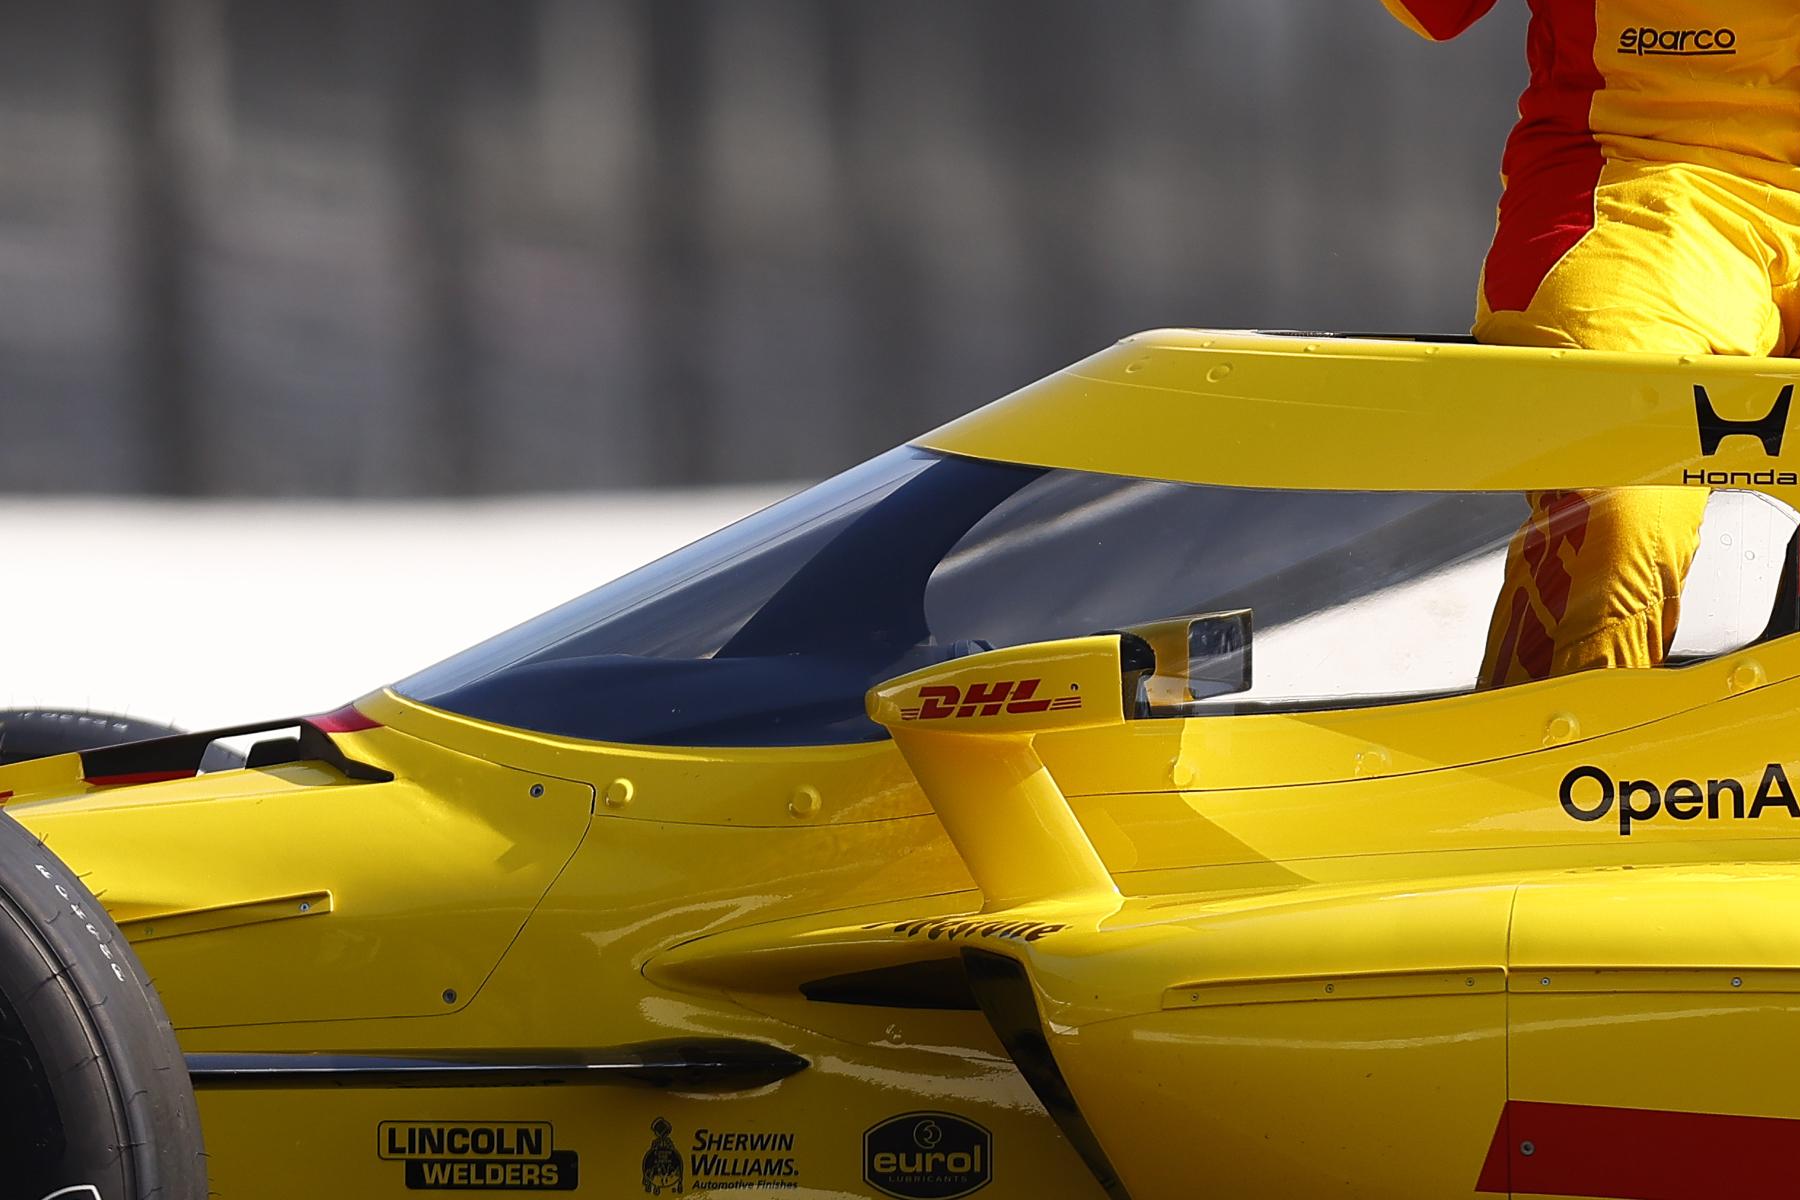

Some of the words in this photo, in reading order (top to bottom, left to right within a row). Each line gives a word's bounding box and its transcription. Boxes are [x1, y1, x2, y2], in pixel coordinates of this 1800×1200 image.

[1619, 27, 1736, 56] sparco
[1683, 470, 1798, 486] Honda
[917, 679, 1053, 720] DHL
[388, 1127, 543, 1155] LINCOLN
[692, 1129, 795, 1151] SHERWIN
[873, 1144, 981, 1173] eurol
[422, 1163, 559, 1185] WELDERS
[692, 1179, 757, 1190] Automotive
[757, 1179, 799, 1190] Finishes
